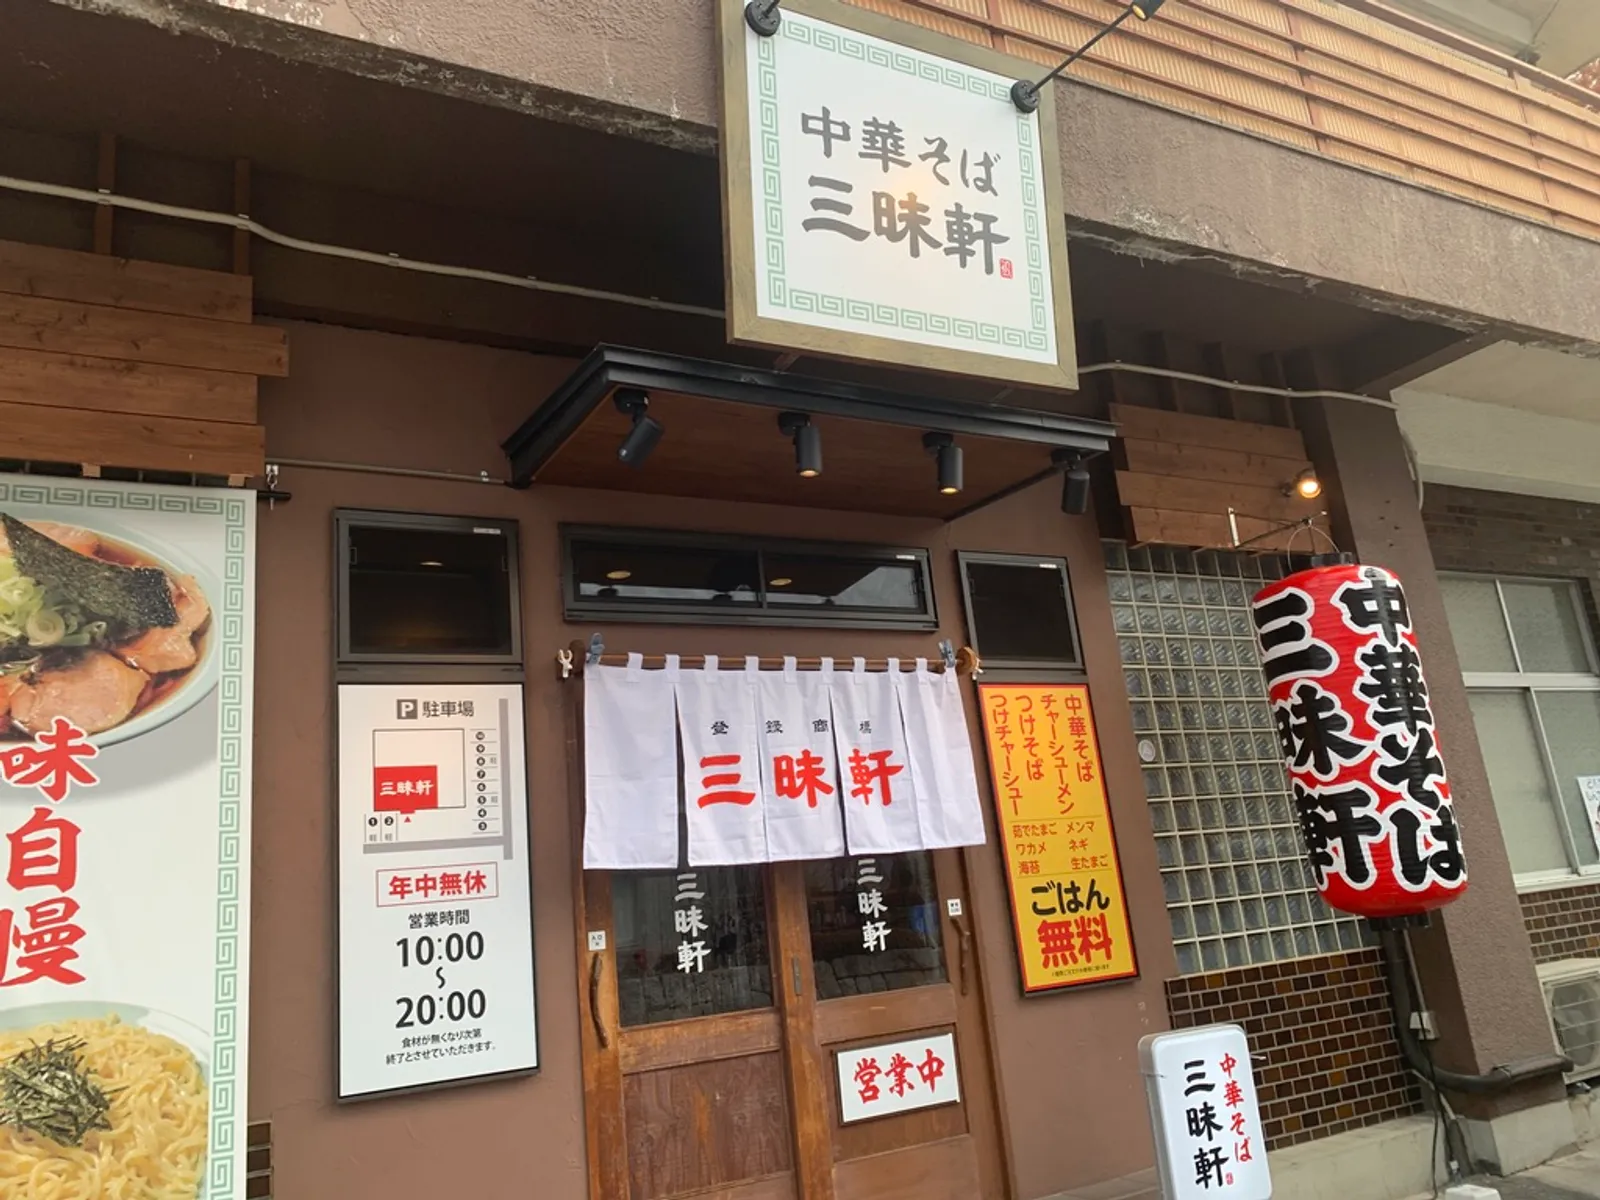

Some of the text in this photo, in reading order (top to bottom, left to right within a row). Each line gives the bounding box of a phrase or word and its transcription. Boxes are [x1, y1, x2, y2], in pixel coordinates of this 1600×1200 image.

[801, 105, 1001, 197] 中華そば
[422, 701, 474, 718] 駐車場
[989, 693, 1023, 816] つけチャーシュー
[1015, 694, 1045, 782] つけそば
[1040, 693, 1075, 815] チャーシューメン
[1064, 693, 1095, 783] 中華そば
[1012, 822, 1057, 838] 茹でたまご
[1066, 820, 1095, 834] メンマ
[1068, 837, 1089, 852] ネギ
[0, 718, 98, 987] 味自慢
[1015, 841, 1047, 856] ワカメ
[1018, 859, 1040, 875] 海苔
[1071, 854, 1108, 870] 生たまご
[388, 869, 487, 900] 年中無休
[1030, 878, 1110, 917] ごはん
[408, 909, 470, 930] 営業時間
[396, 930, 485, 967] 10:00
[1037, 912, 1113, 969] 無料
[395, 988, 487, 1029] 20:00
[853, 1048, 945, 1104] 営業中
[1219, 1052, 1253, 1163] 中華そば
